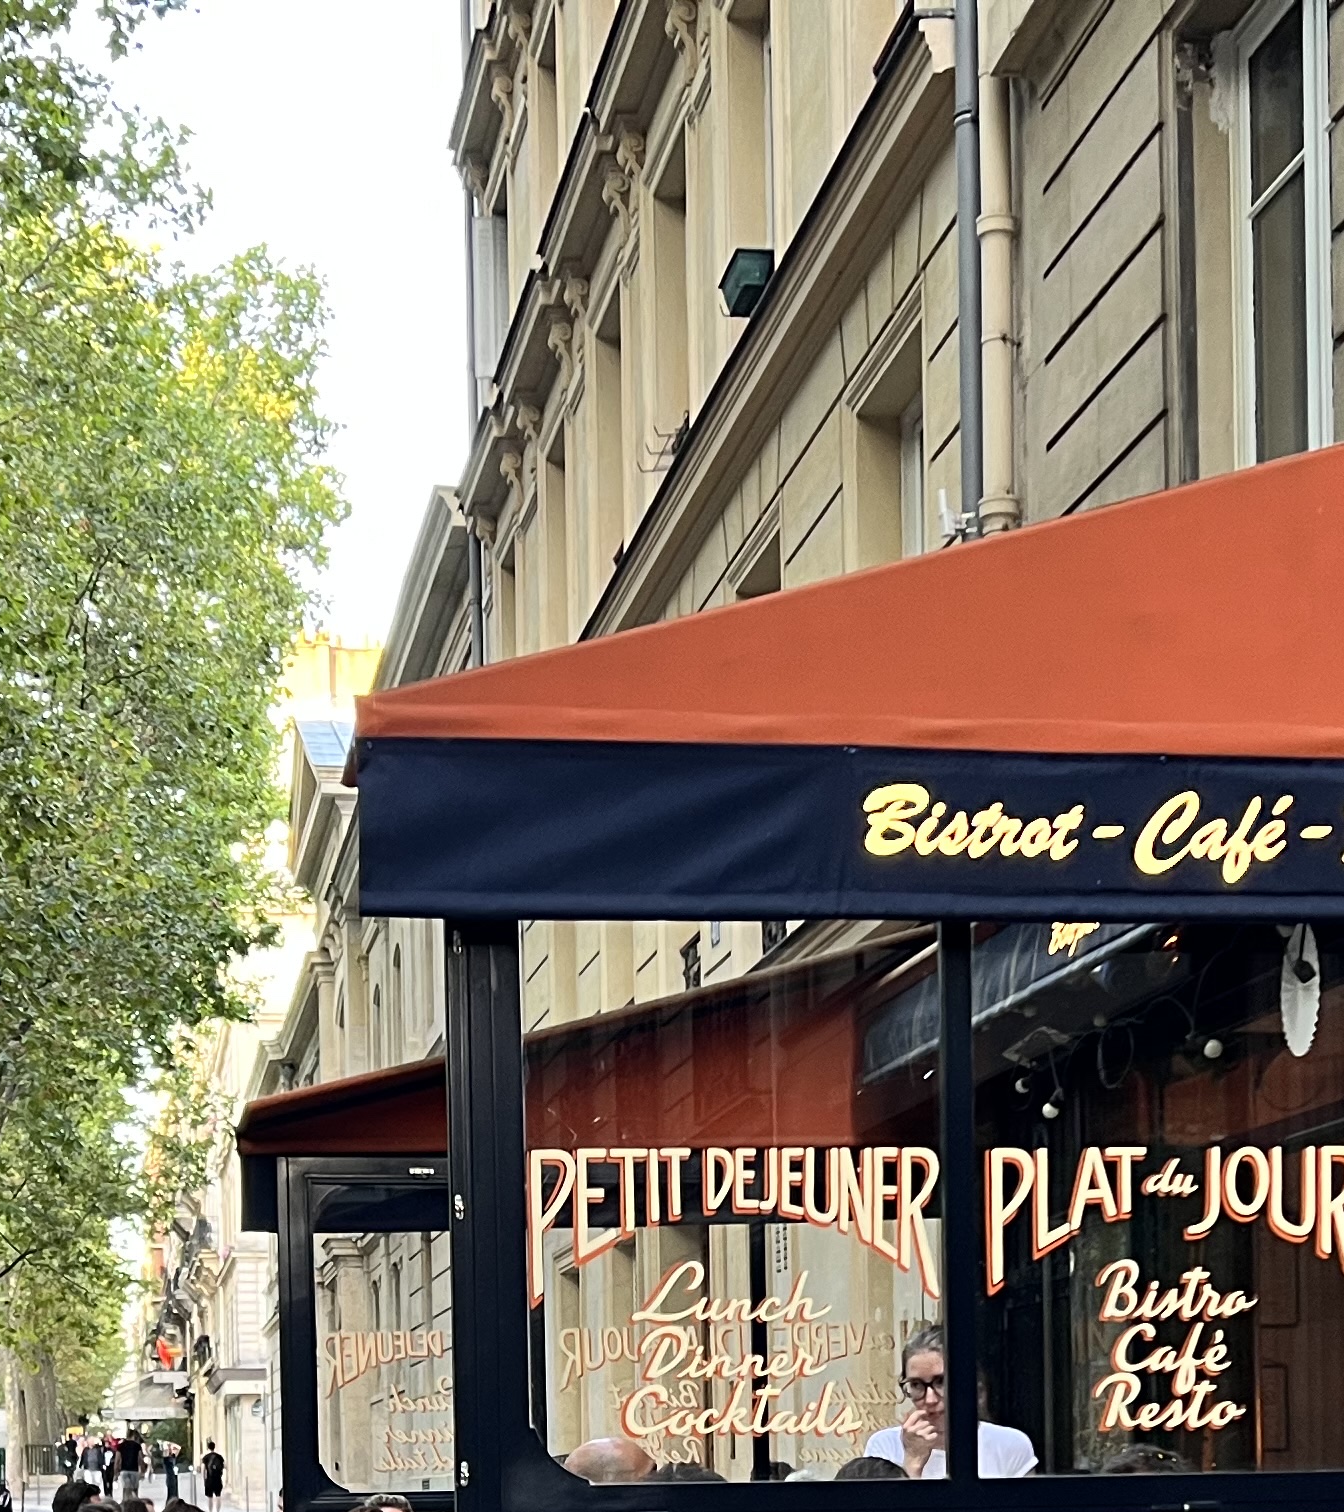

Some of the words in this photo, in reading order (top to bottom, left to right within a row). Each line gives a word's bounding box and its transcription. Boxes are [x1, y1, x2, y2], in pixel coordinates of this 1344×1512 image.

[863, 783, 1085, 861] Bistrot
[1133, 791, 1295, 884] Café
[527, 1147, 692, 1309] PETIT
[702, 1147, 942, 1299] DEJEUNER
[985, 1147, 1147, 1296] PLAT
[1141, 1158, 1199, 1197] du
[631, 1261, 832, 1325] Lunch
[1095, 1258, 1259, 1322] Bistro
[638, 1326, 829, 1381] Dinner
[1110, 1322, 1233, 1396] Café
[621, 1381, 864, 1439] Cocktails
[1093, 1372, 1248, 1432] Resto
